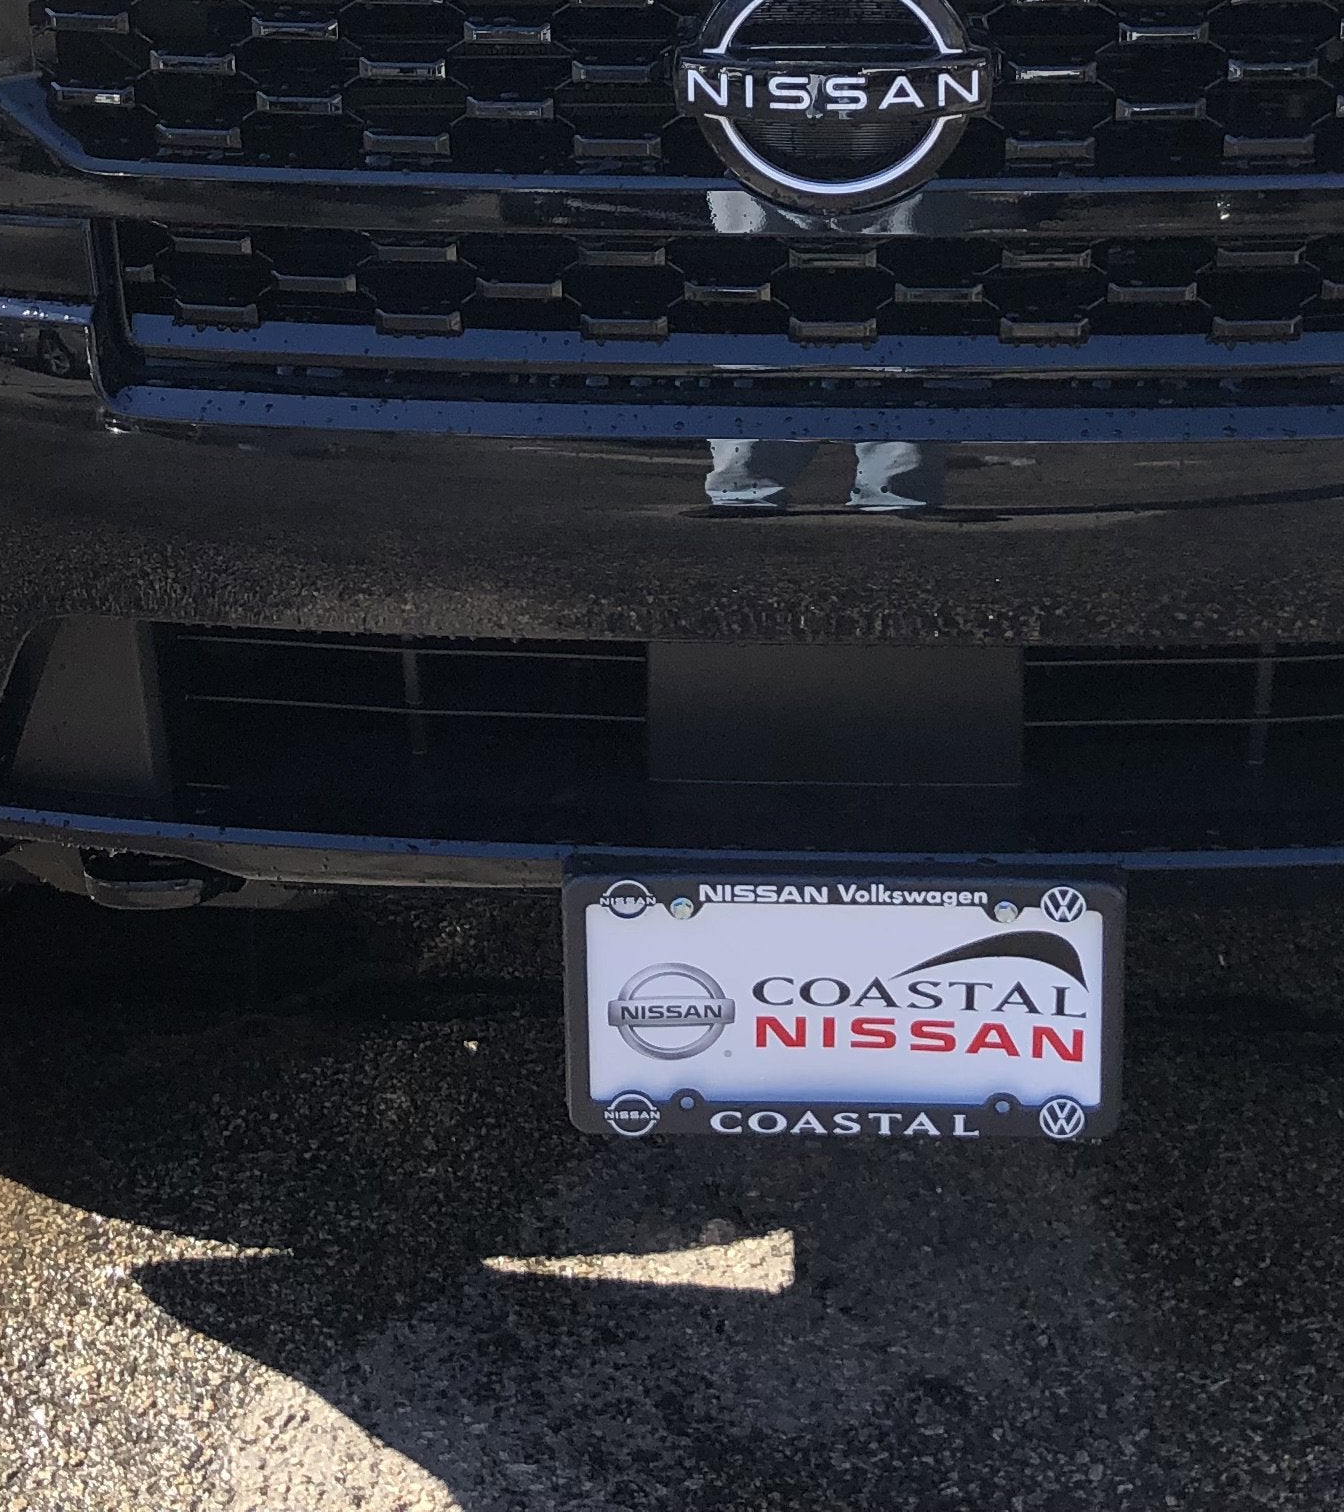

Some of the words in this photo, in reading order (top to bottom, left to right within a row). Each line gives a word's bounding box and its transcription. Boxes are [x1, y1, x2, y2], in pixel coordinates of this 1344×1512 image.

[687, 69, 979, 110] NISSAN
[600, 896, 656, 905] NISSAN
[699, 884, 828, 904] NISSAN
[837, 884, 988, 907] Volkswagen
[752, 976, 1087, 1019] COASTAL
[621, 1004, 722, 1021] NISSAN
[756, 1015, 1084, 1062] NISSAN
[604, 1110, 661, 1120] NISSAN
[709, 1111, 980, 1137] COASTAL
